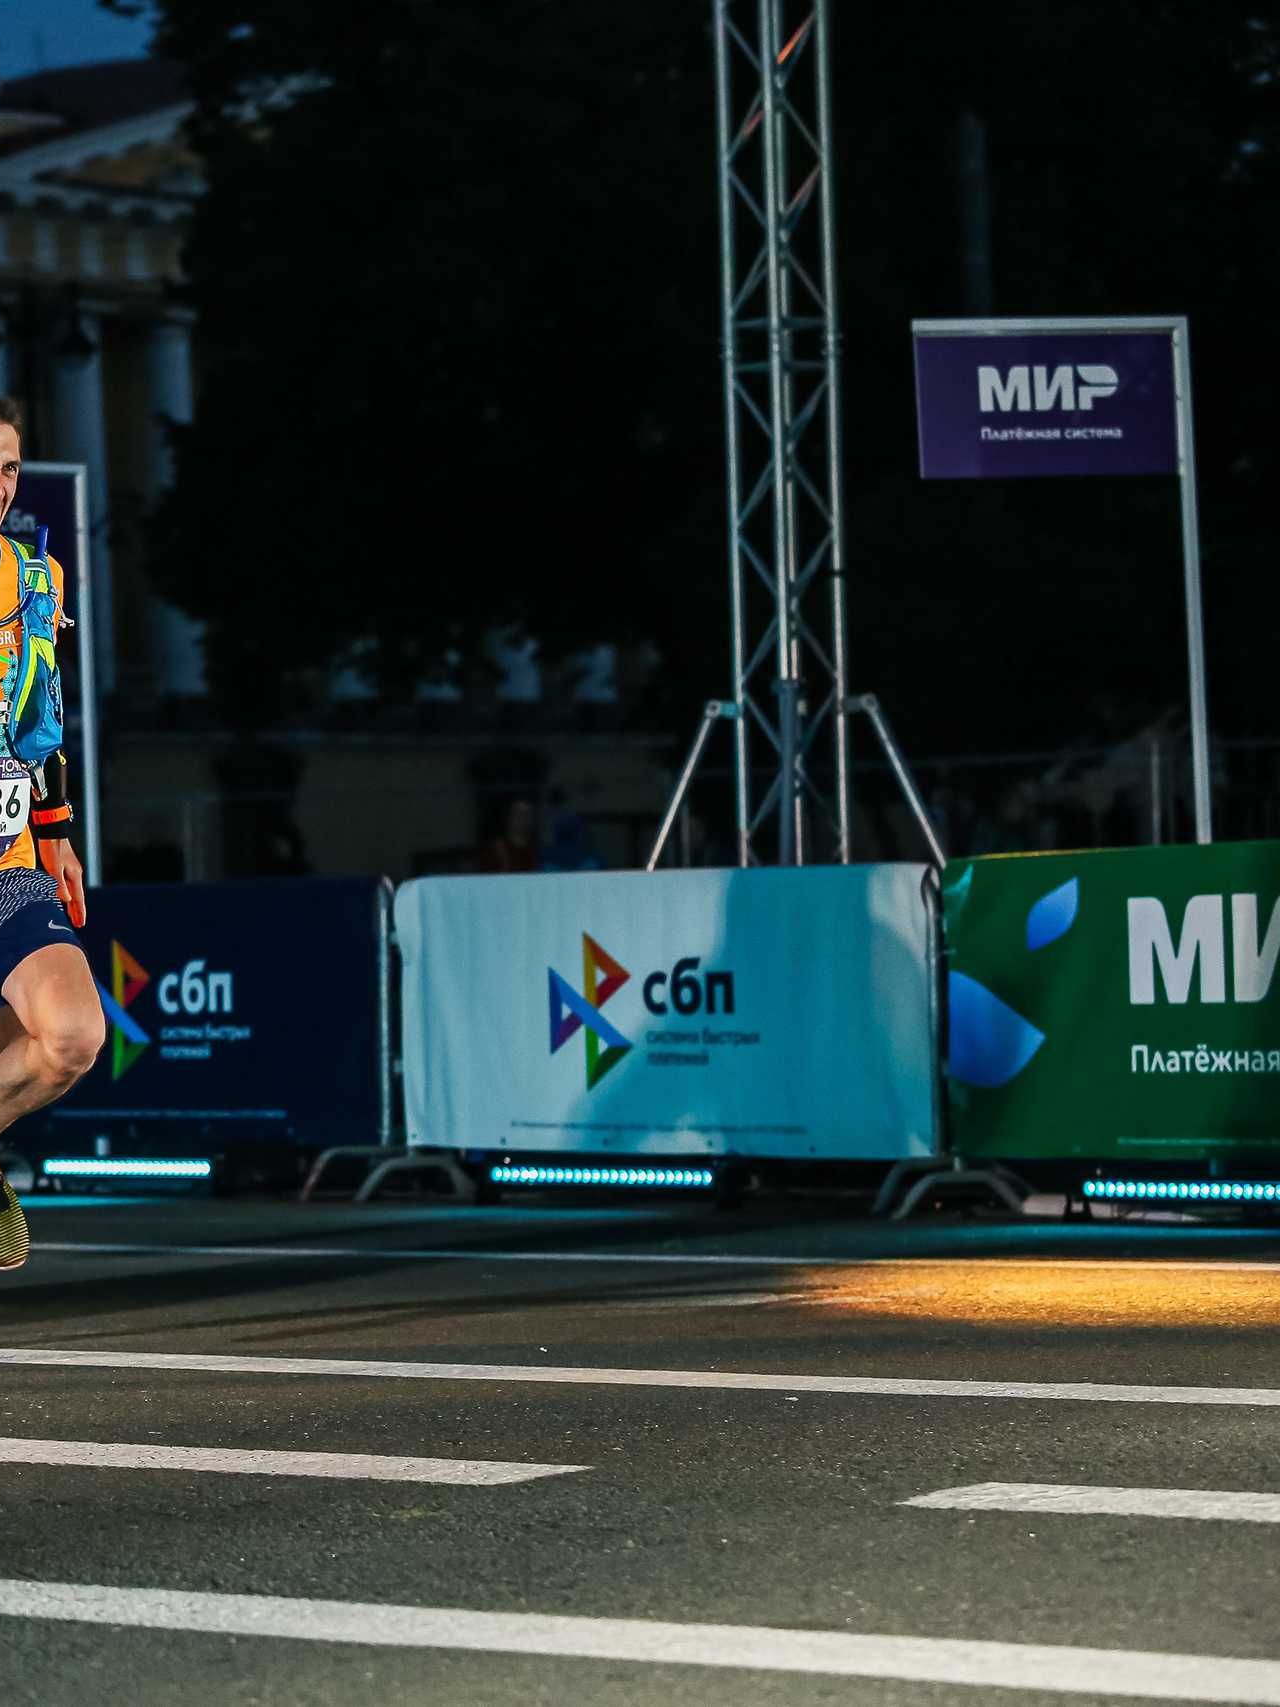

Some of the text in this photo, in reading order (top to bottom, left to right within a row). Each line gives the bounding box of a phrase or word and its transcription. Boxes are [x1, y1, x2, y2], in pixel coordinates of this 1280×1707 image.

[978, 365, 1119, 412] МИР
[981, 426, 1122, 441] Платёжная система
[157, 959, 233, 1015] сбп
[642, 955, 735, 1016] сбп
[1131, 1043, 1280, 1073] Платёжная
